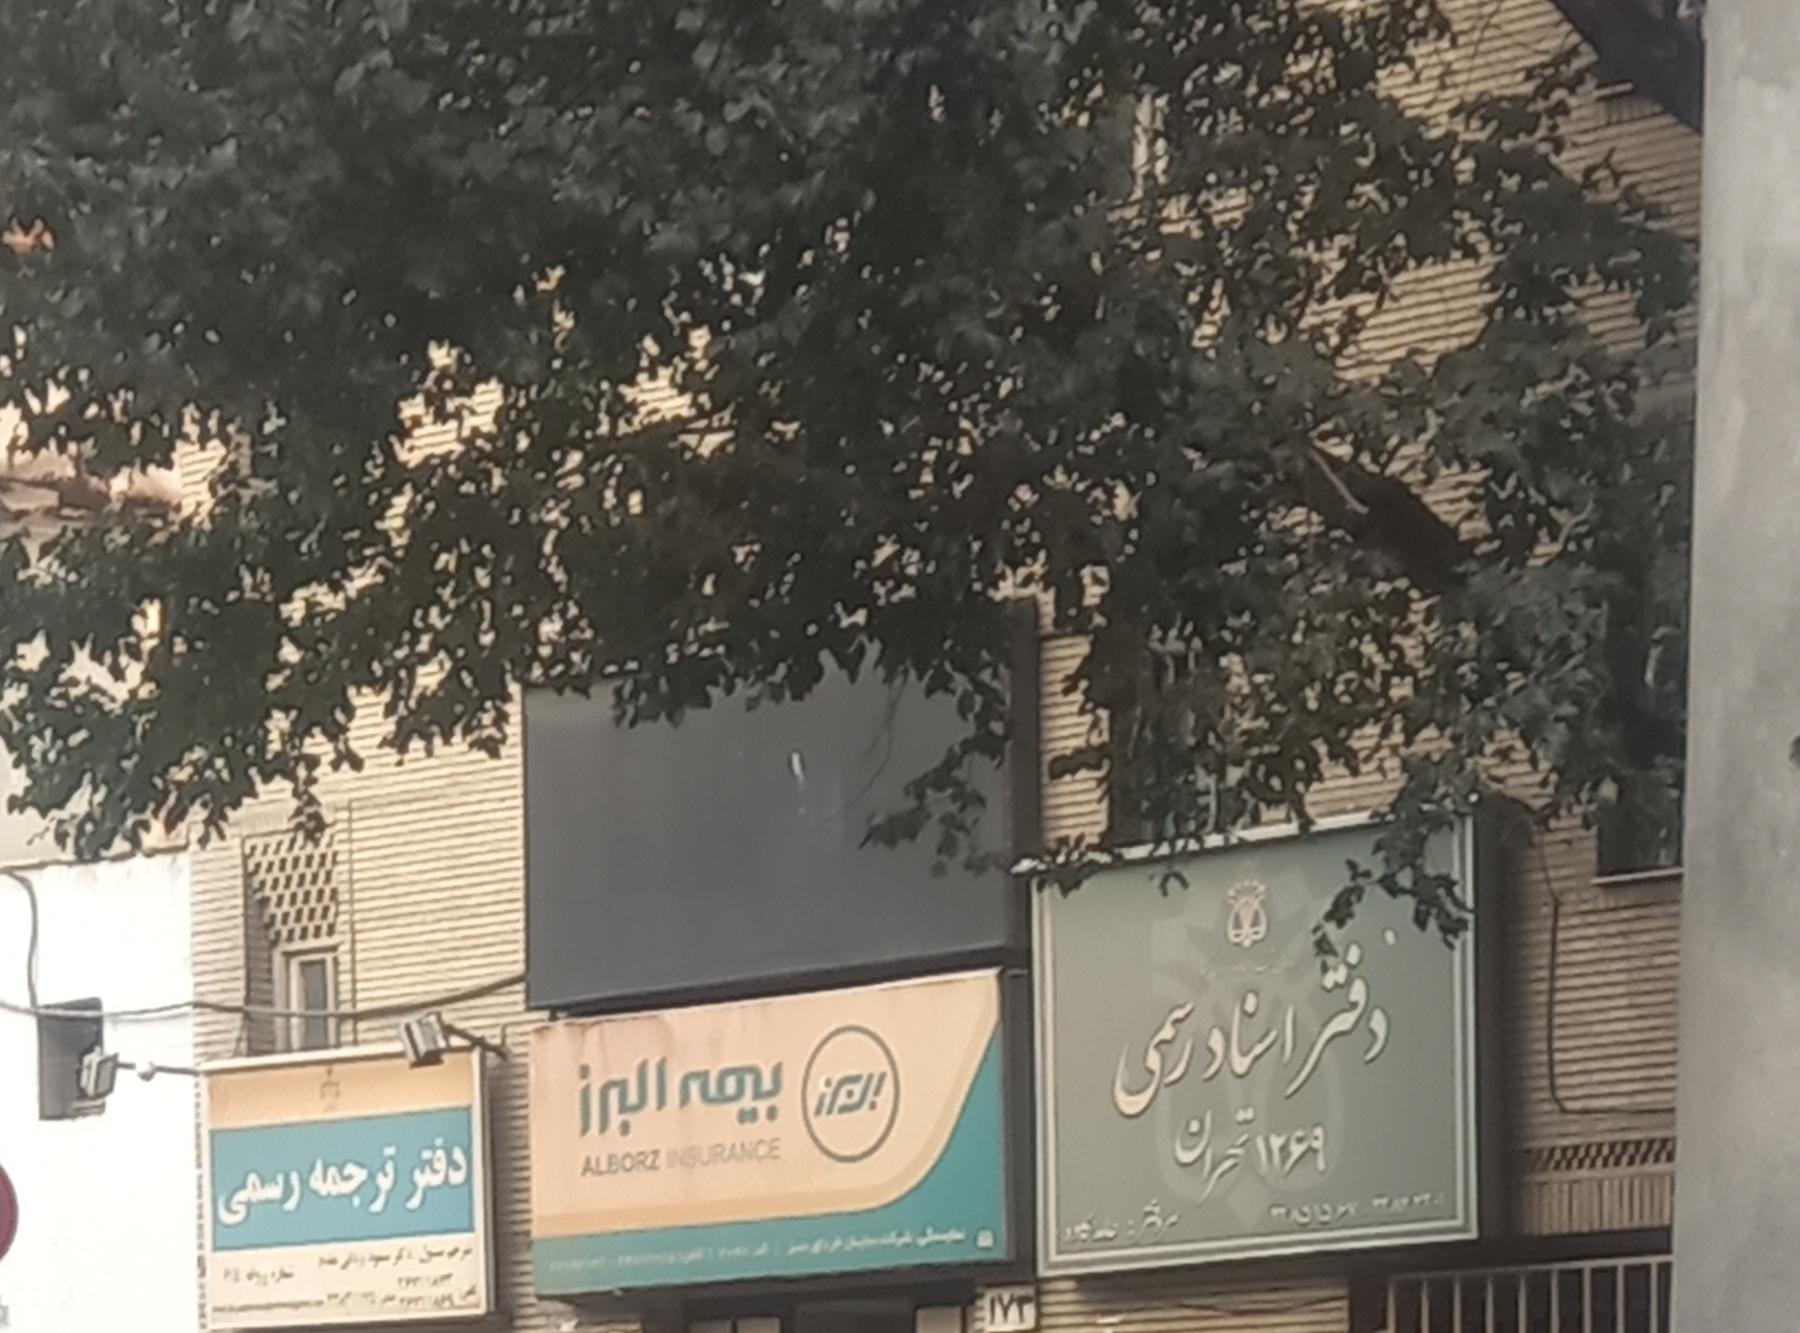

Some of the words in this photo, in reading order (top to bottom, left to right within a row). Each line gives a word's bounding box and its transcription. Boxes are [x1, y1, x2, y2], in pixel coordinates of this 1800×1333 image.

[1202, 991, 1296, 1082] اسناد
[1285, 944, 1389, 1099] دفتر
[679, 1061, 783, 1125] بیمه
[1113, 1003, 1194, 1116] رسمی
[579, 1056, 667, 1138] البرز
[309, 1145, 396, 1213] ترجمه
[405, 1136, 468, 1210] دفتر
[580, 1149, 662, 1178] ALBORZ
[665, 1137, 781, 1169] INSURANCE
[1174, 1107, 1256, 1202] تهران
[1255, 1125, 1326, 1177] ۱۲۶۹
[217, 1170, 300, 1225] رسمی
[989, 1294, 1034, 1326] ۱۷۳
